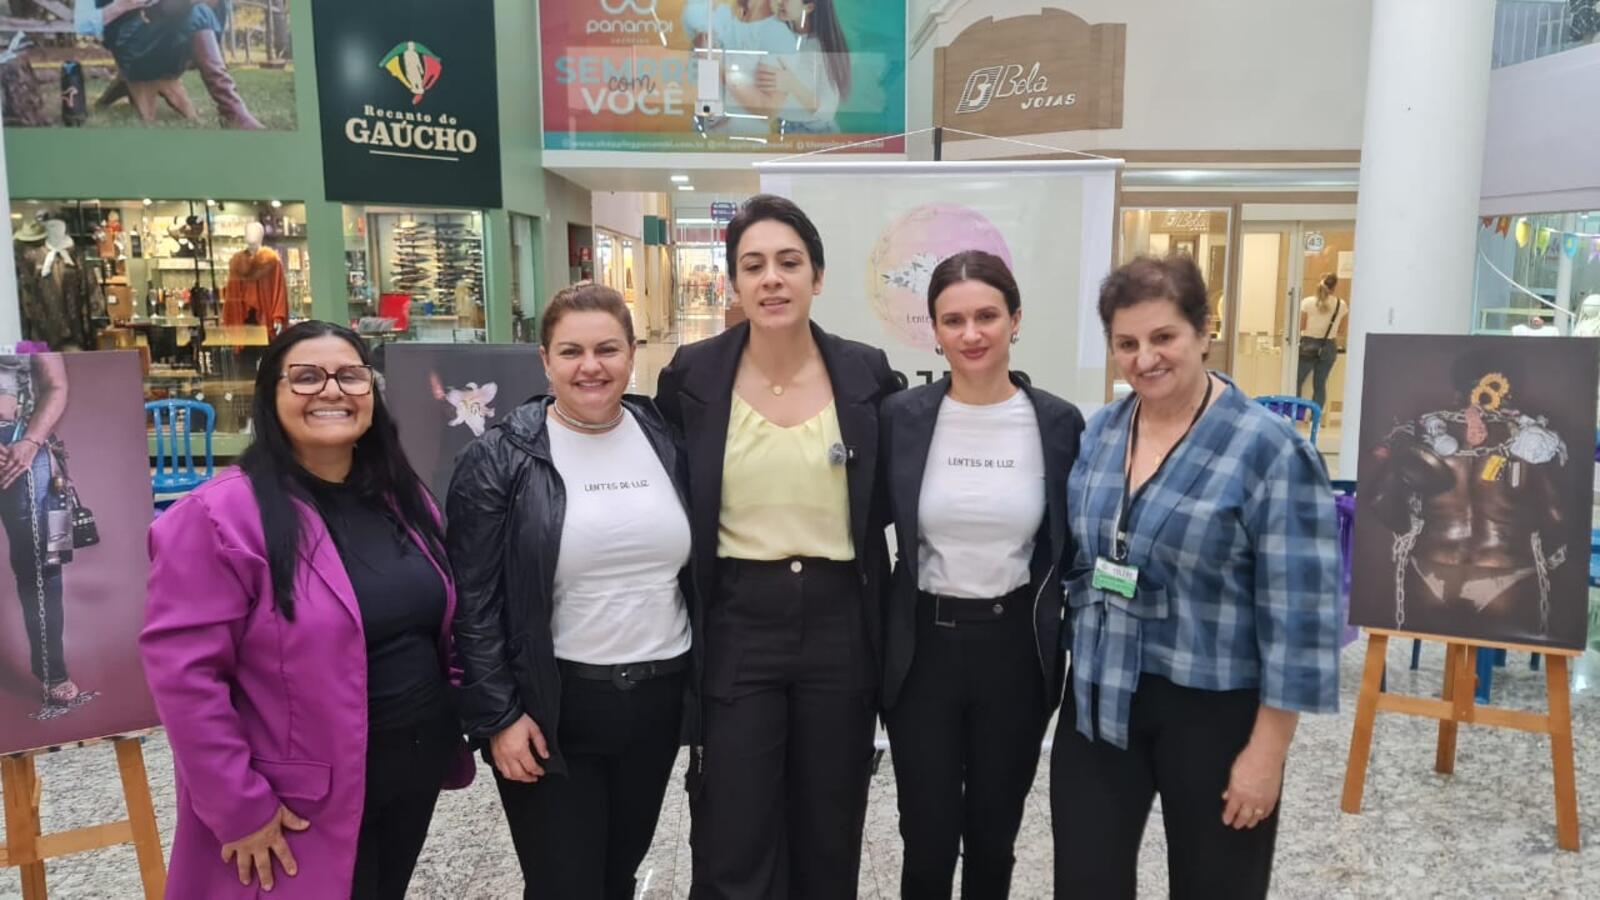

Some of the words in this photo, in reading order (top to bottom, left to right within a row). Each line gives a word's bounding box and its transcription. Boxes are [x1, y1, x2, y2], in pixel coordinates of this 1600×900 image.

[608, 74, 656, 93] com
[995, 62, 1048, 99] Bela
[581, 81, 684, 115] VOCÊ
[1021, 94, 1076, 109] JOIAS
[364, 104, 432, 123] Recanto
[439, 114, 457, 125] do
[345, 118, 477, 153] GAÚCHO
[948, 456, 982, 467] LENTES
[997, 459, 1015, 468] LUZ
[584, 482, 618, 491] LENTES
